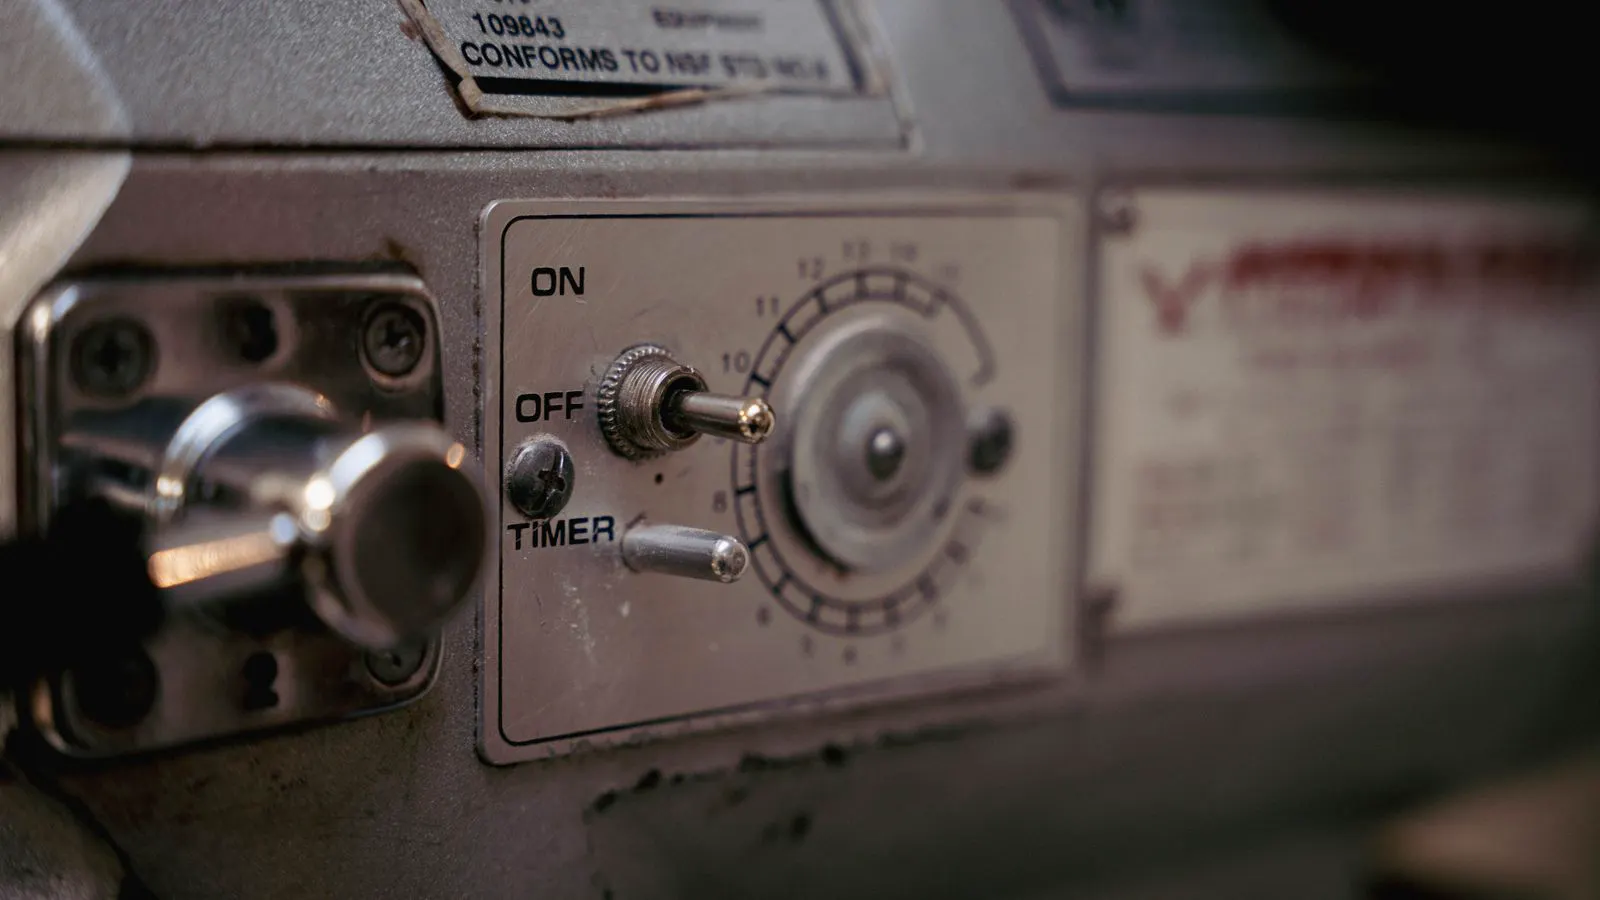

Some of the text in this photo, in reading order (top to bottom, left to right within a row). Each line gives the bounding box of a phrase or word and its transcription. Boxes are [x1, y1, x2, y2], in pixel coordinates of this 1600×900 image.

[472, 13, 565, 39] 109843
[461, 42, 618, 72] CONFORMS
[621, 48, 660, 73] TO
[531, 266, 585, 296] ON
[797, 257, 826, 279] 12
[756, 296, 780, 316] 11
[721, 351, 752, 373] 10
[515, 391, 584, 423] OFF
[507, 516, 615, 550] TIMER
